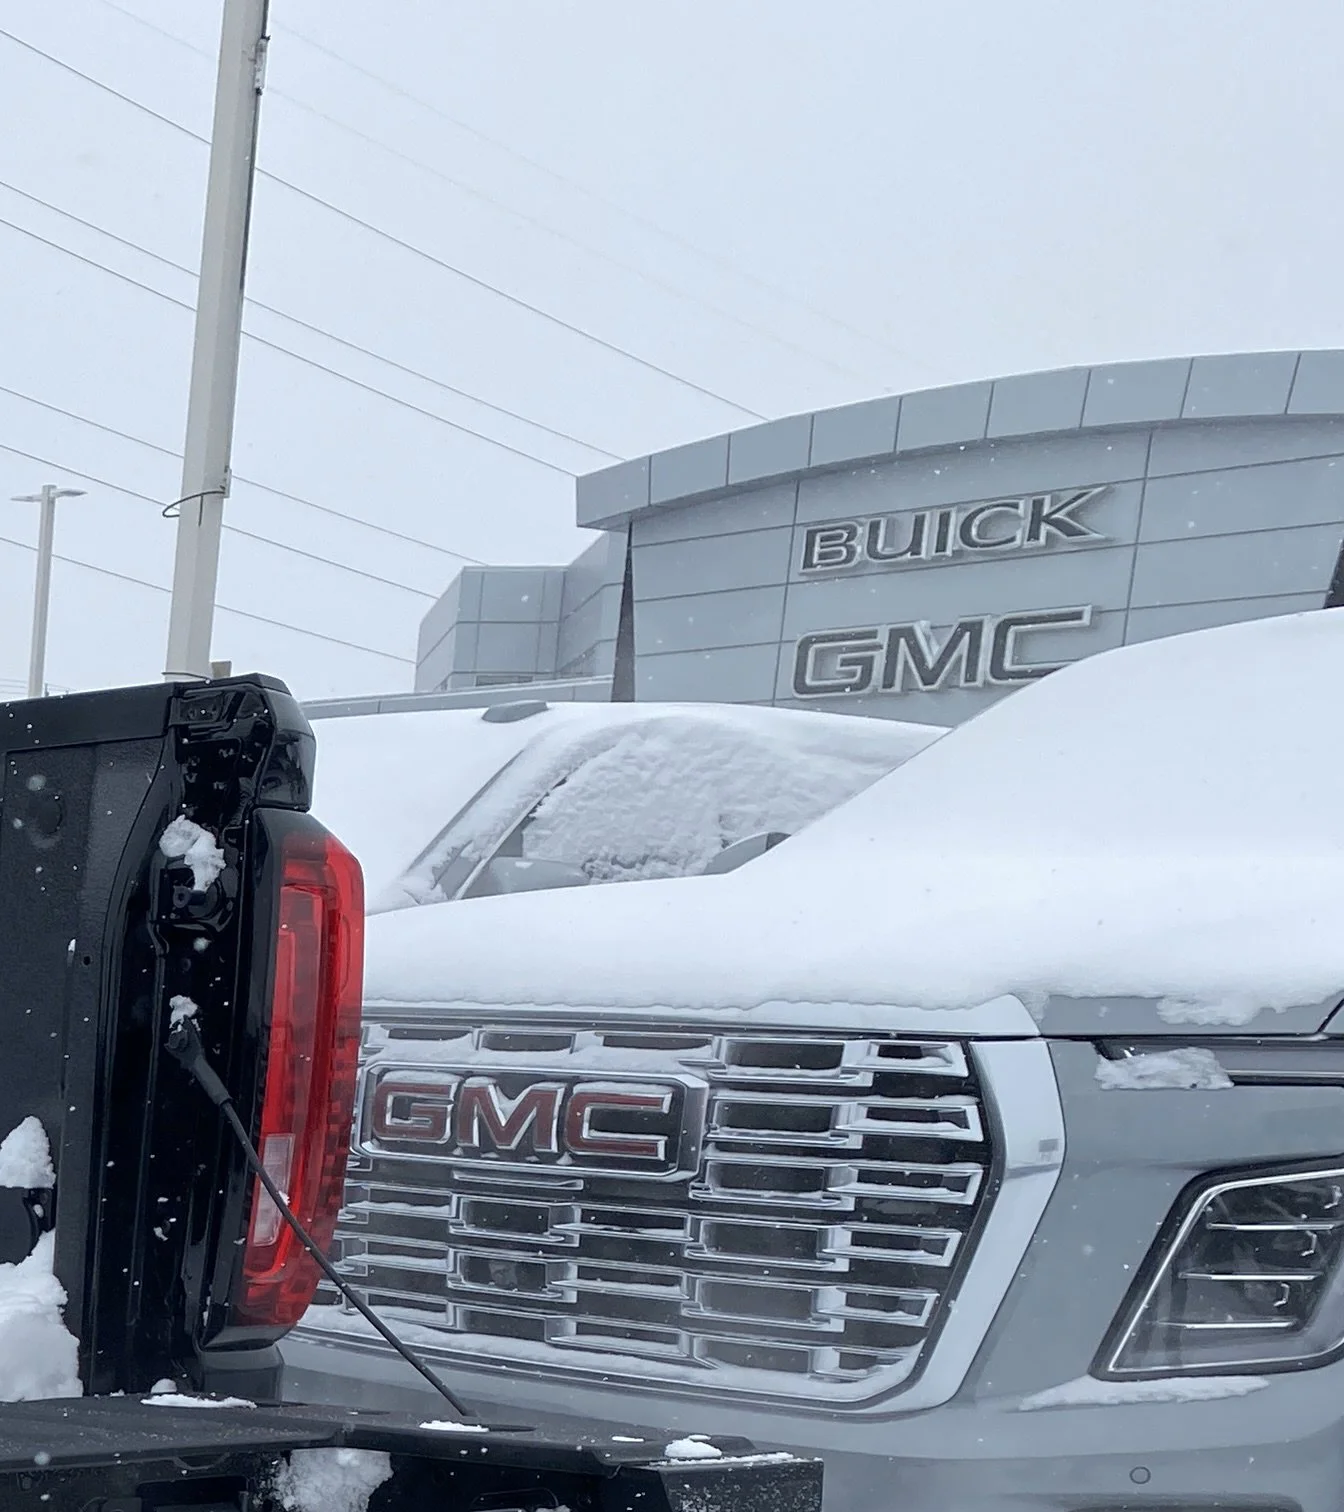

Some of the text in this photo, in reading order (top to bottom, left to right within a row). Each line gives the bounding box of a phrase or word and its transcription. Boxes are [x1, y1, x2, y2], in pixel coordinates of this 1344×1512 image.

[798, 486, 1109, 576] BUICK
[792, 604, 1093, 700] GMC
[372, 1072, 673, 1161] GMC
